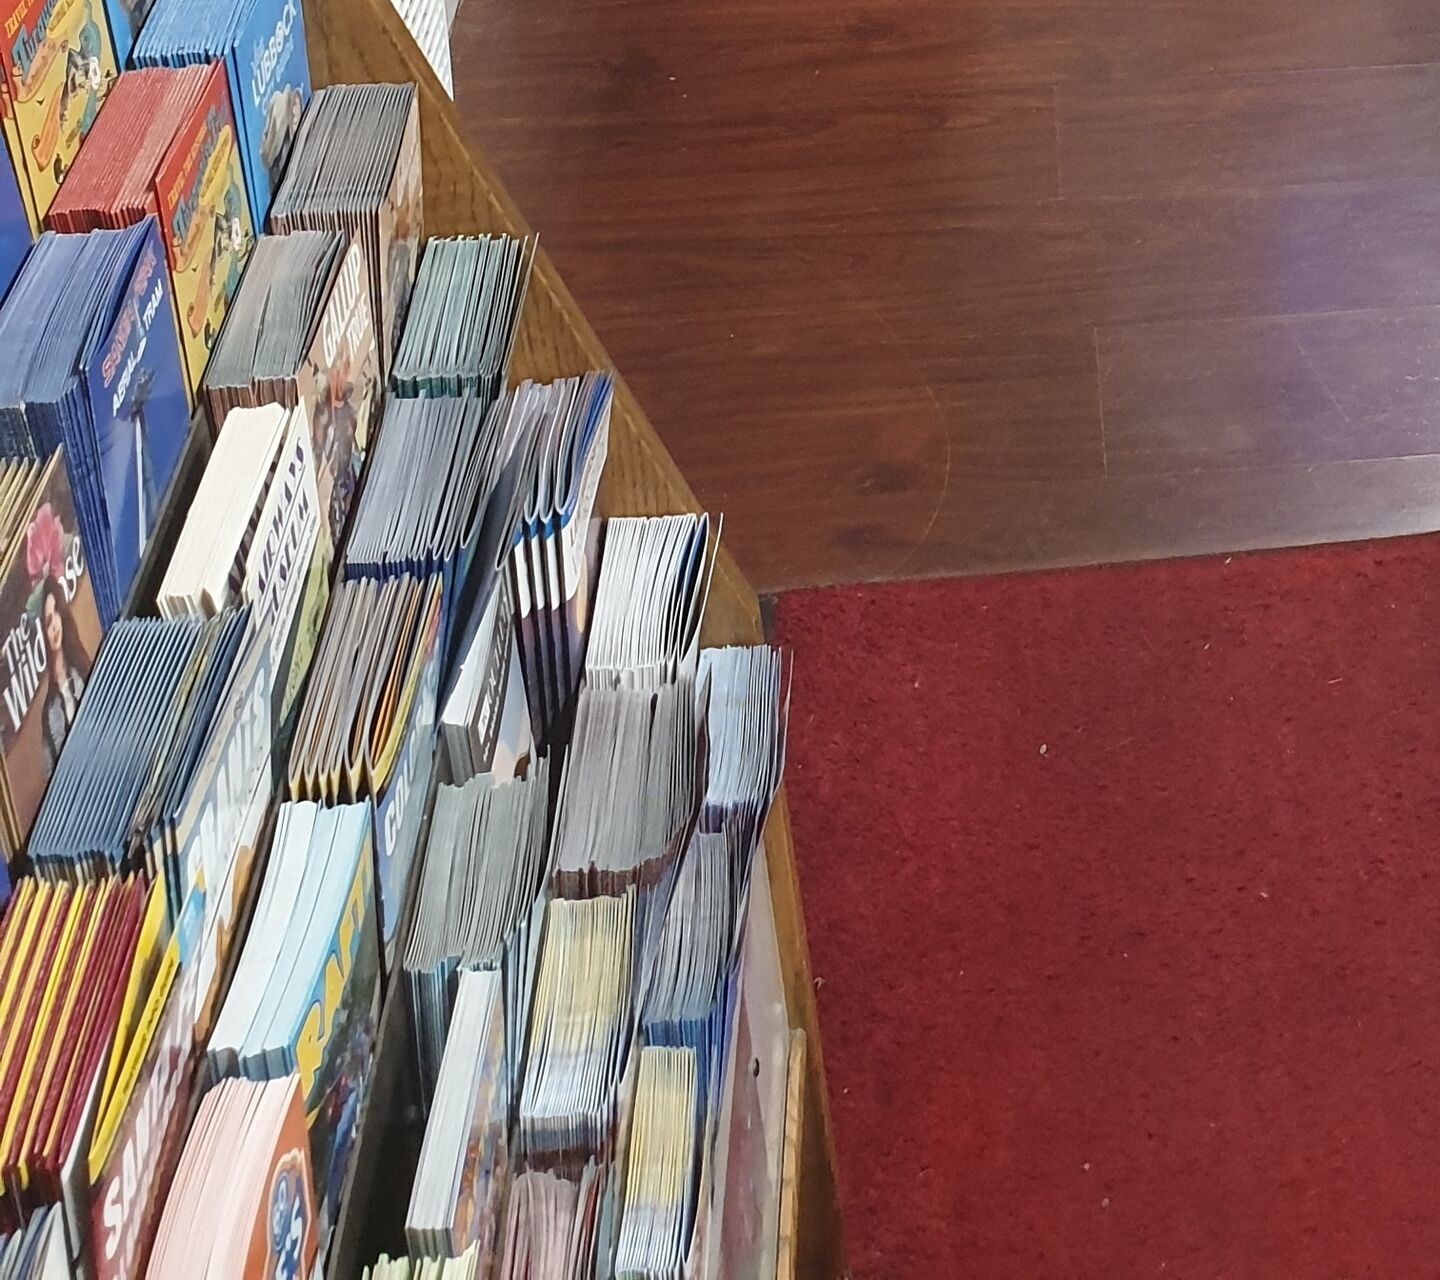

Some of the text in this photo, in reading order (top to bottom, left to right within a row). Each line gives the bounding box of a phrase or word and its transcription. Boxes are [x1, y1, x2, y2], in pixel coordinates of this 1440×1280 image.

[142, 278, 164, 331] TRAM
[2, 612, 31, 675] The
[3, 617, 47, 732] Wild
